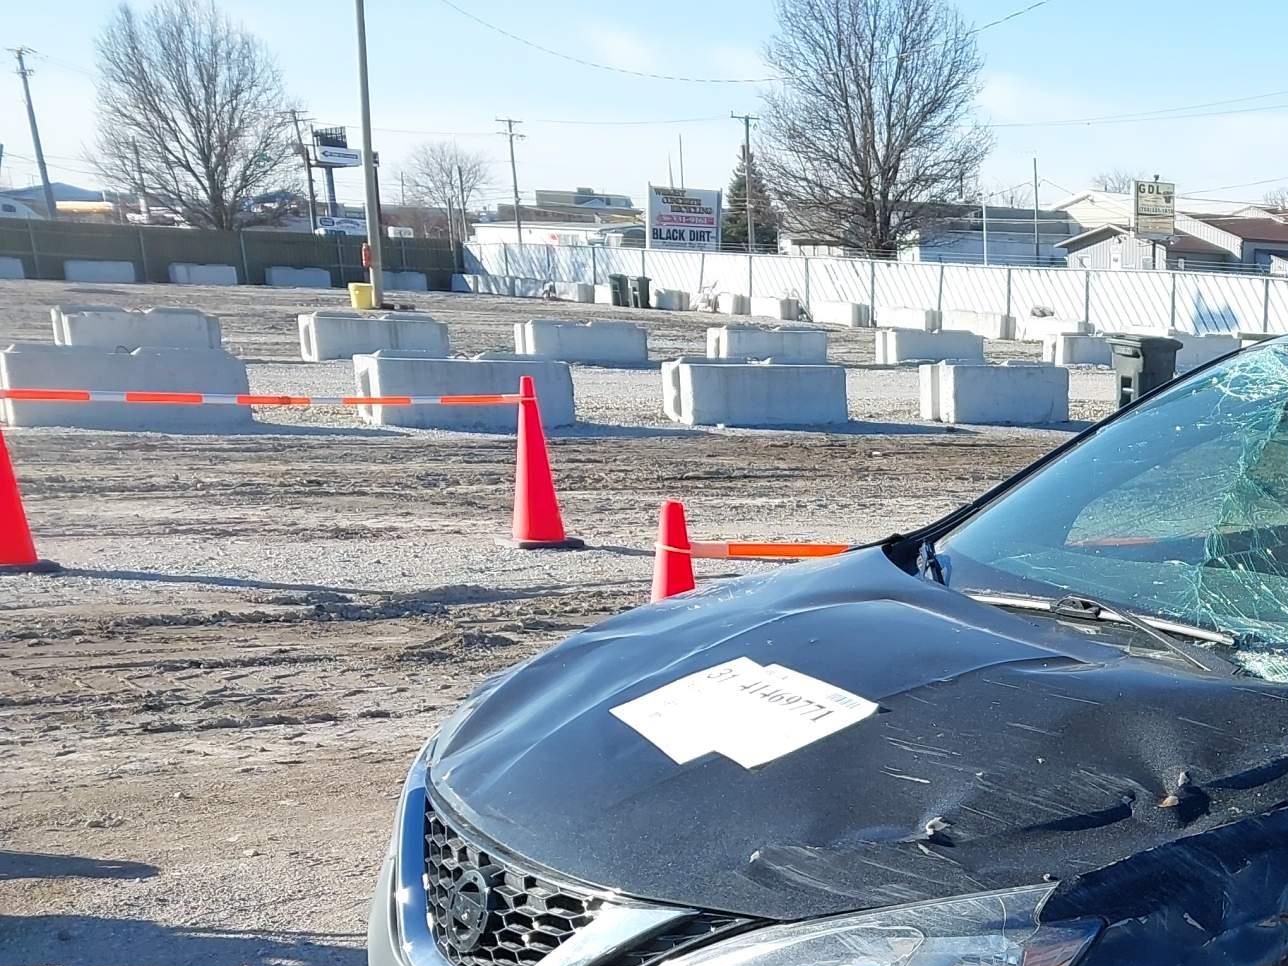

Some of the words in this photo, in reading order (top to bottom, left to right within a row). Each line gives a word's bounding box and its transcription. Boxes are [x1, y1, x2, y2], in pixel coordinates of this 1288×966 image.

[652, 227, 686, 241] BLACK
[707, 668, 739, 683] 31
[740, 681, 834, 721] 41469771
